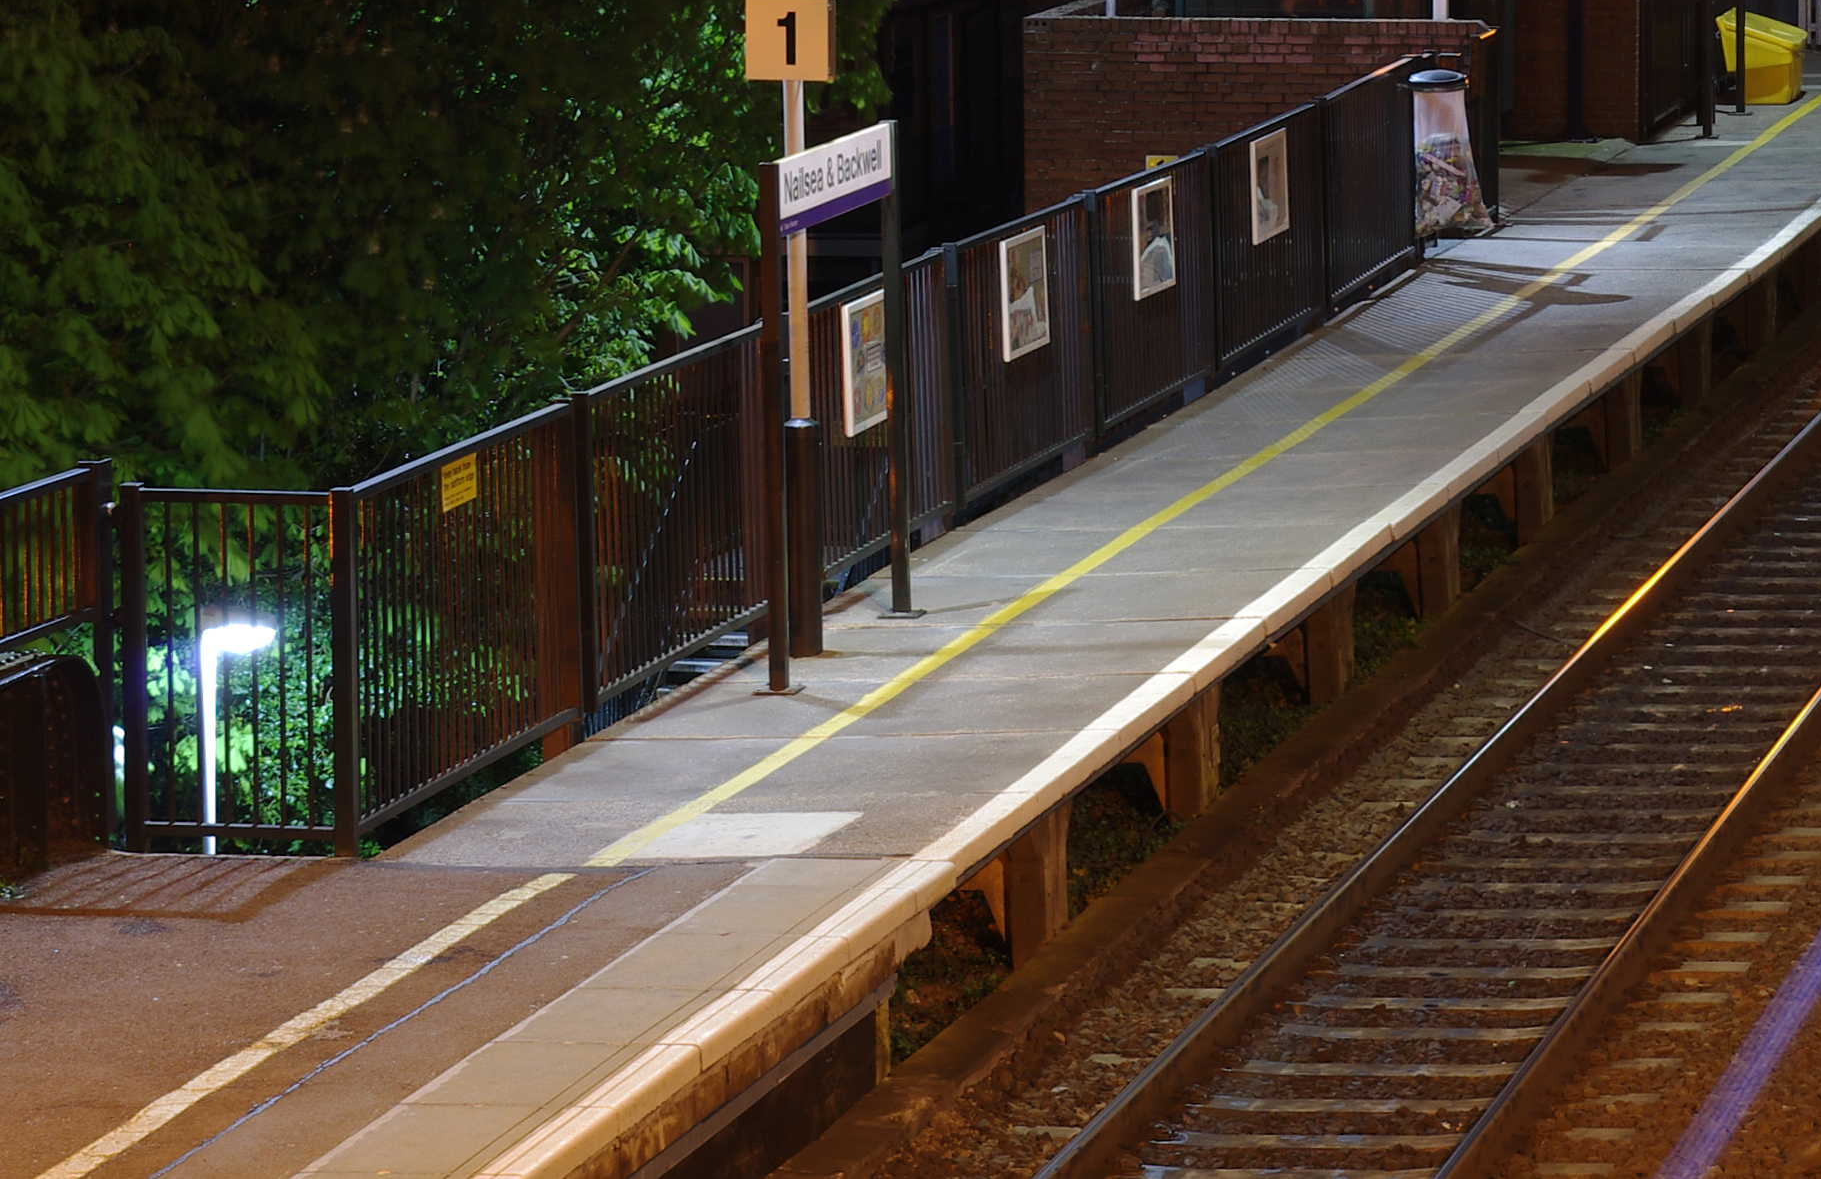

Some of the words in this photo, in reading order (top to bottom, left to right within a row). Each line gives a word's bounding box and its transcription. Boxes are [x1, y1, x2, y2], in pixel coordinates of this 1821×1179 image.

[777, 11, 796, 65] 1
[784, 166, 823, 204] Nailsea
[827, 156, 835, 188] &
[837, 139, 882, 185] Backwell
